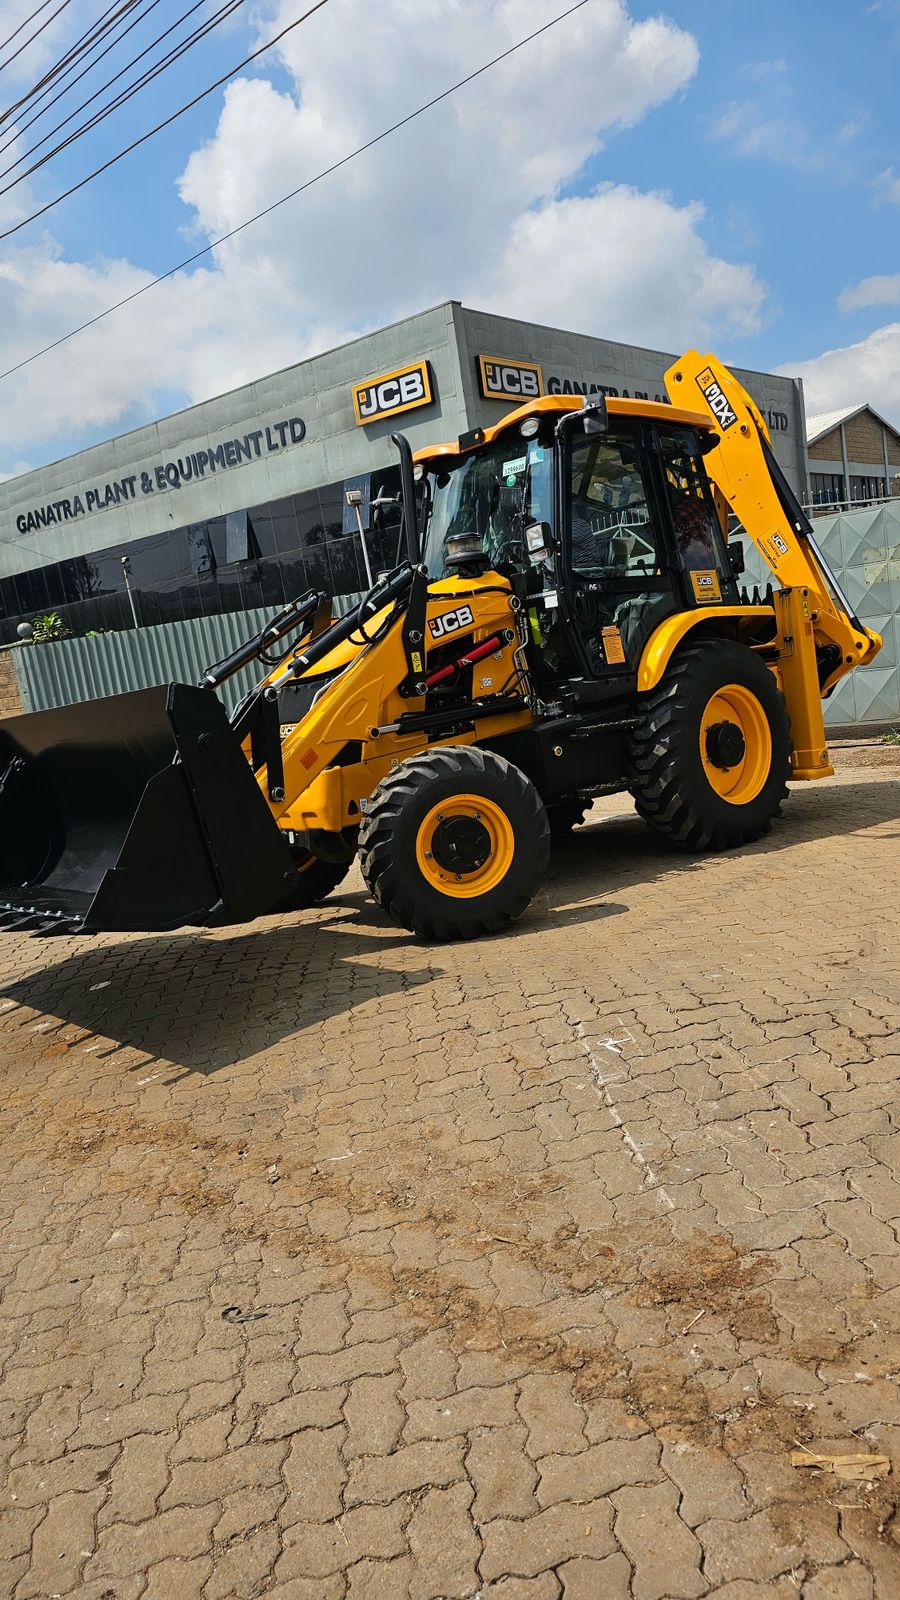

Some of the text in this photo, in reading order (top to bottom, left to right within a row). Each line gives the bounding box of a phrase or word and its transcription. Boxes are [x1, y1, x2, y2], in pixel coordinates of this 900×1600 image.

[360, 372, 424, 416] JCB
[488, 366, 538, 396] JCB
[705, 383, 735, 425] 3DX
[768, 411, 788, 430] LTD
[16, 416, 307, 534] GANATRA PLANT & EQUIPMENT LTD
[772, 534, 788, 555] JCB
[698, 577, 713, 585] JCB
[432, 607, 473, 638] JCB
